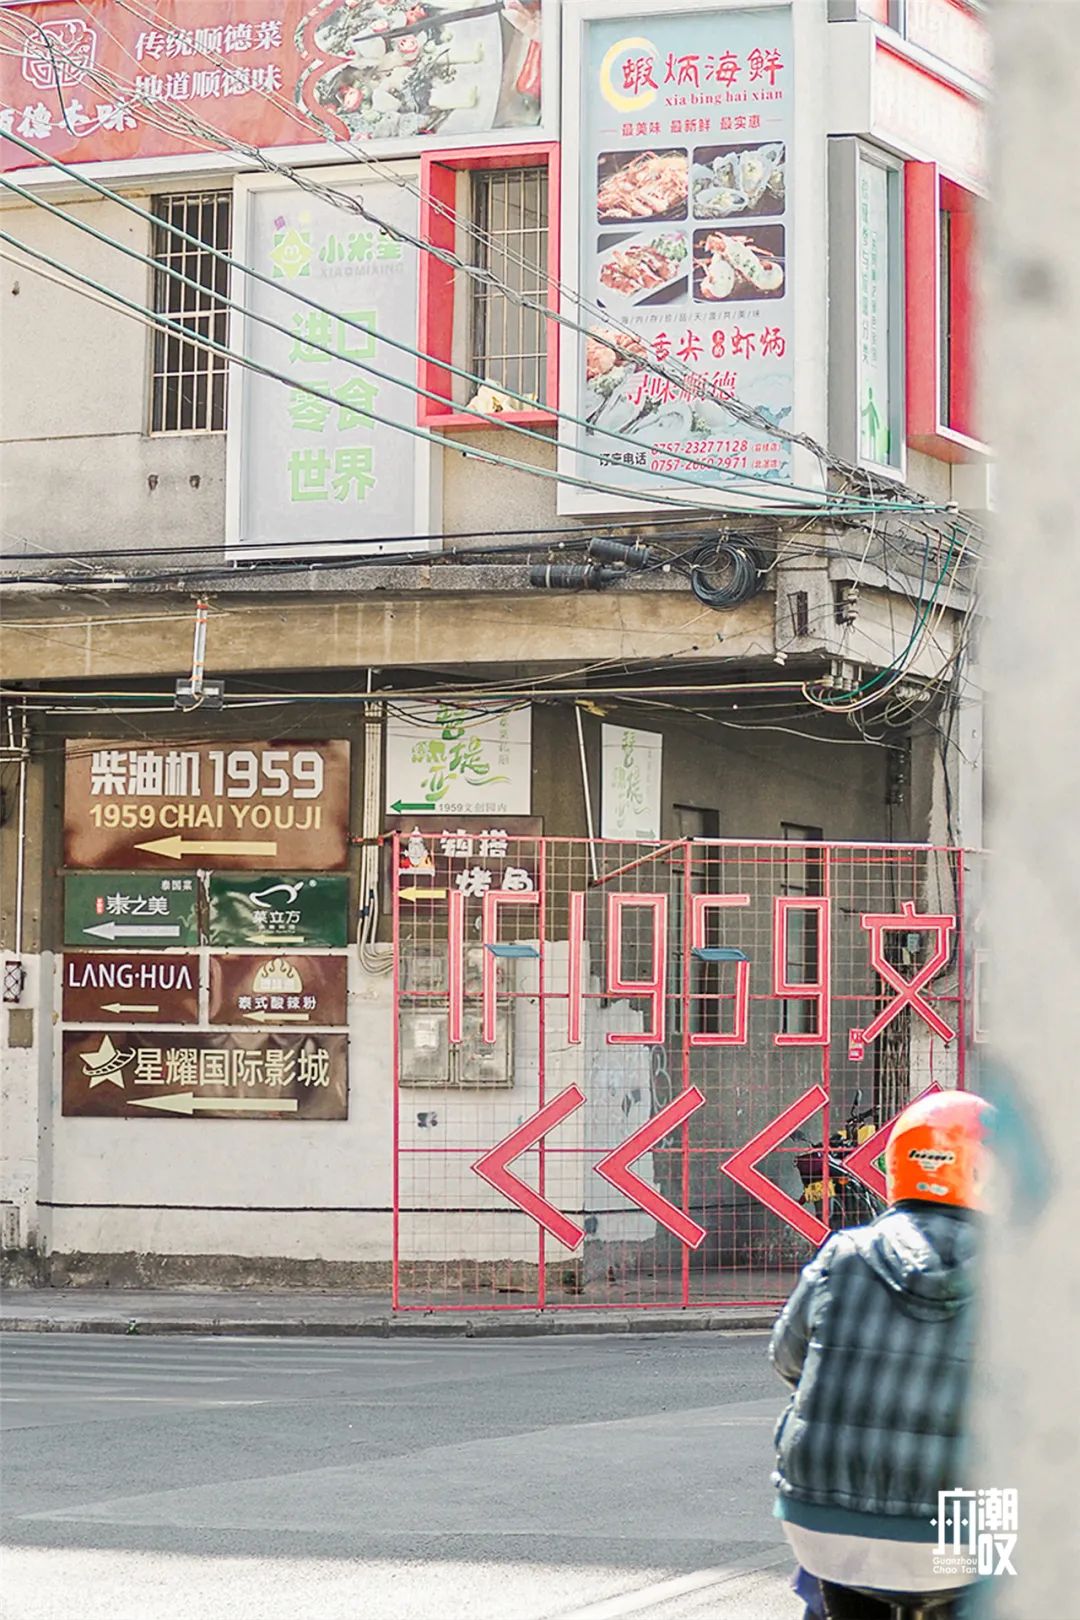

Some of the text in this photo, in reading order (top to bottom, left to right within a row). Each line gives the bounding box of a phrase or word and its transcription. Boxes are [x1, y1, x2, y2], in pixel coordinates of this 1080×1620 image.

[136, 21, 283, 60] 传统顺德菜
[135, 65, 283, 101] 地道顺德味
[665, 88, 783, 106] xia bing hai xian
[621, 121, 662, 137] 最美味
[719, 114, 761, 130] 最实惠
[289, 310, 377, 363] 进口
[289, 377, 379, 432] 零食
[288, 448, 375, 502] 世界
[90, 804, 322, 830] 1959 CHAI YOUJI
[238, 995, 316, 1010] 泰式酸辣粉
[134, 1047, 330, 1087] 星耀国际影城
